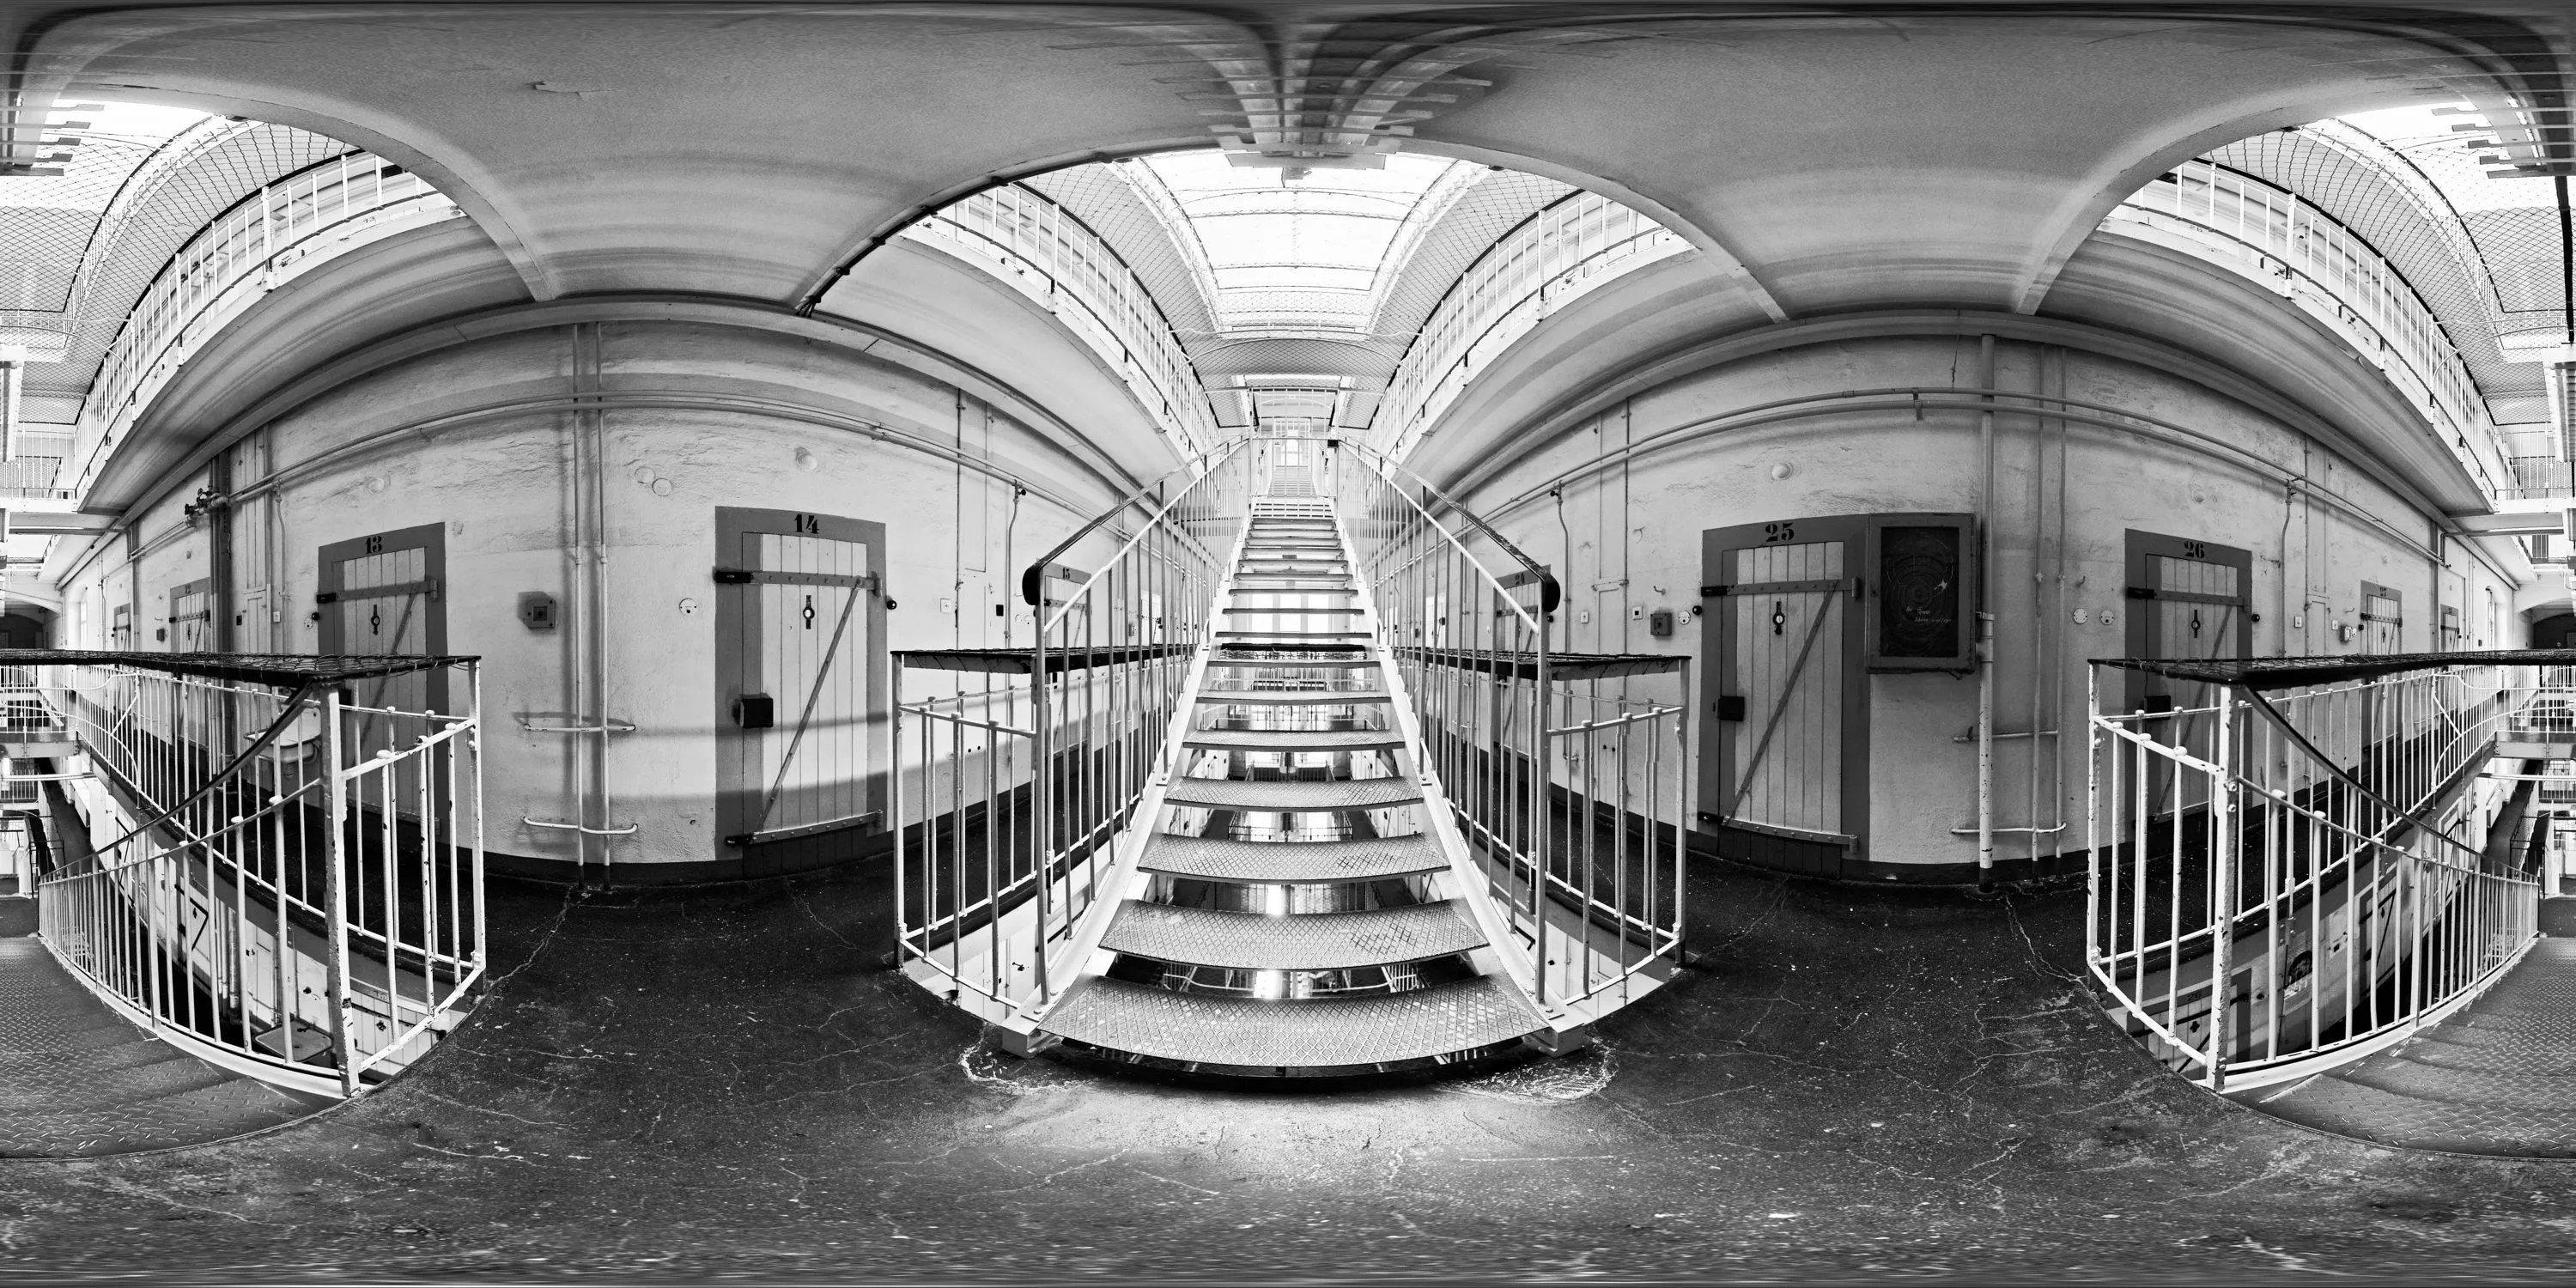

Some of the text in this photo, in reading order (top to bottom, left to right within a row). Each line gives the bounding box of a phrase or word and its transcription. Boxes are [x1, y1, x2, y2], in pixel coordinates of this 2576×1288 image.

[794, 513, 820, 533] 14
[1765, 522, 1795, 543] 25
[365, 536, 383, 555] 13
[2184, 541, 2205, 559] 26
[1062, 567, 1070, 580] 15
[1515, 572, 1526, 586] 24
